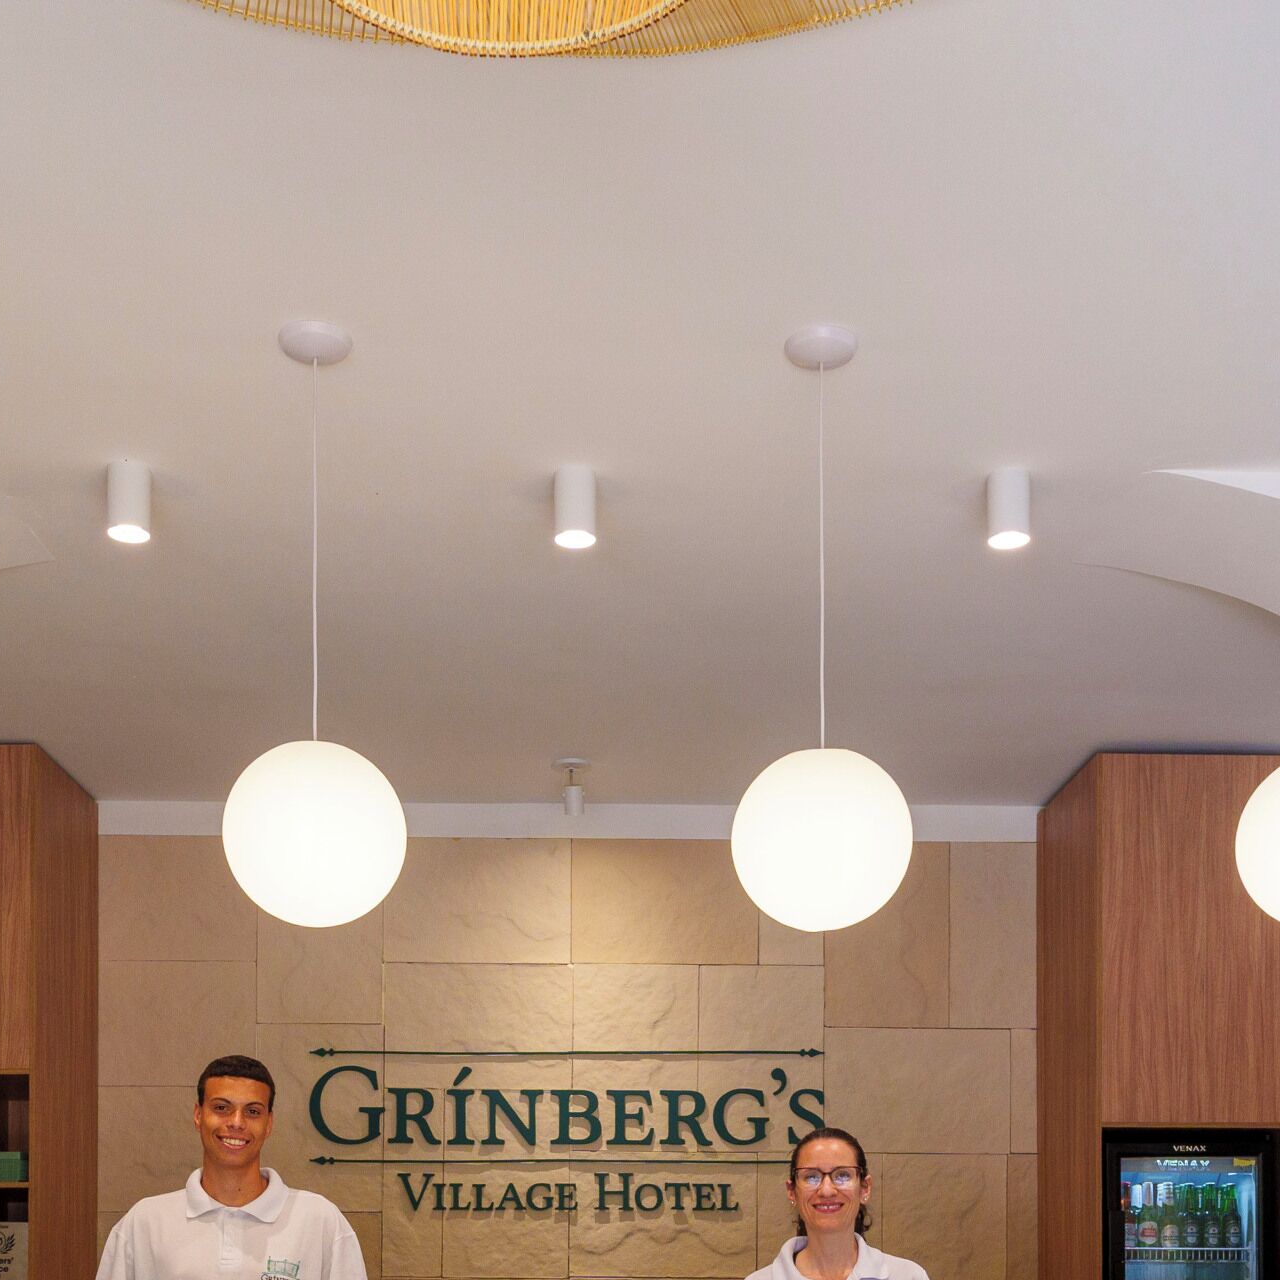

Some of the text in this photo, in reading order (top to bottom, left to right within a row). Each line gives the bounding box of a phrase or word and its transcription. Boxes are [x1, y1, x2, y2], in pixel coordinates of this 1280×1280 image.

[309, 1065, 826, 1147] GRÍNBERG'S
[1173, 1144, 1207, 1152] VENAX
[396, 1172, 740, 1212] VILLAGE HOTEL
